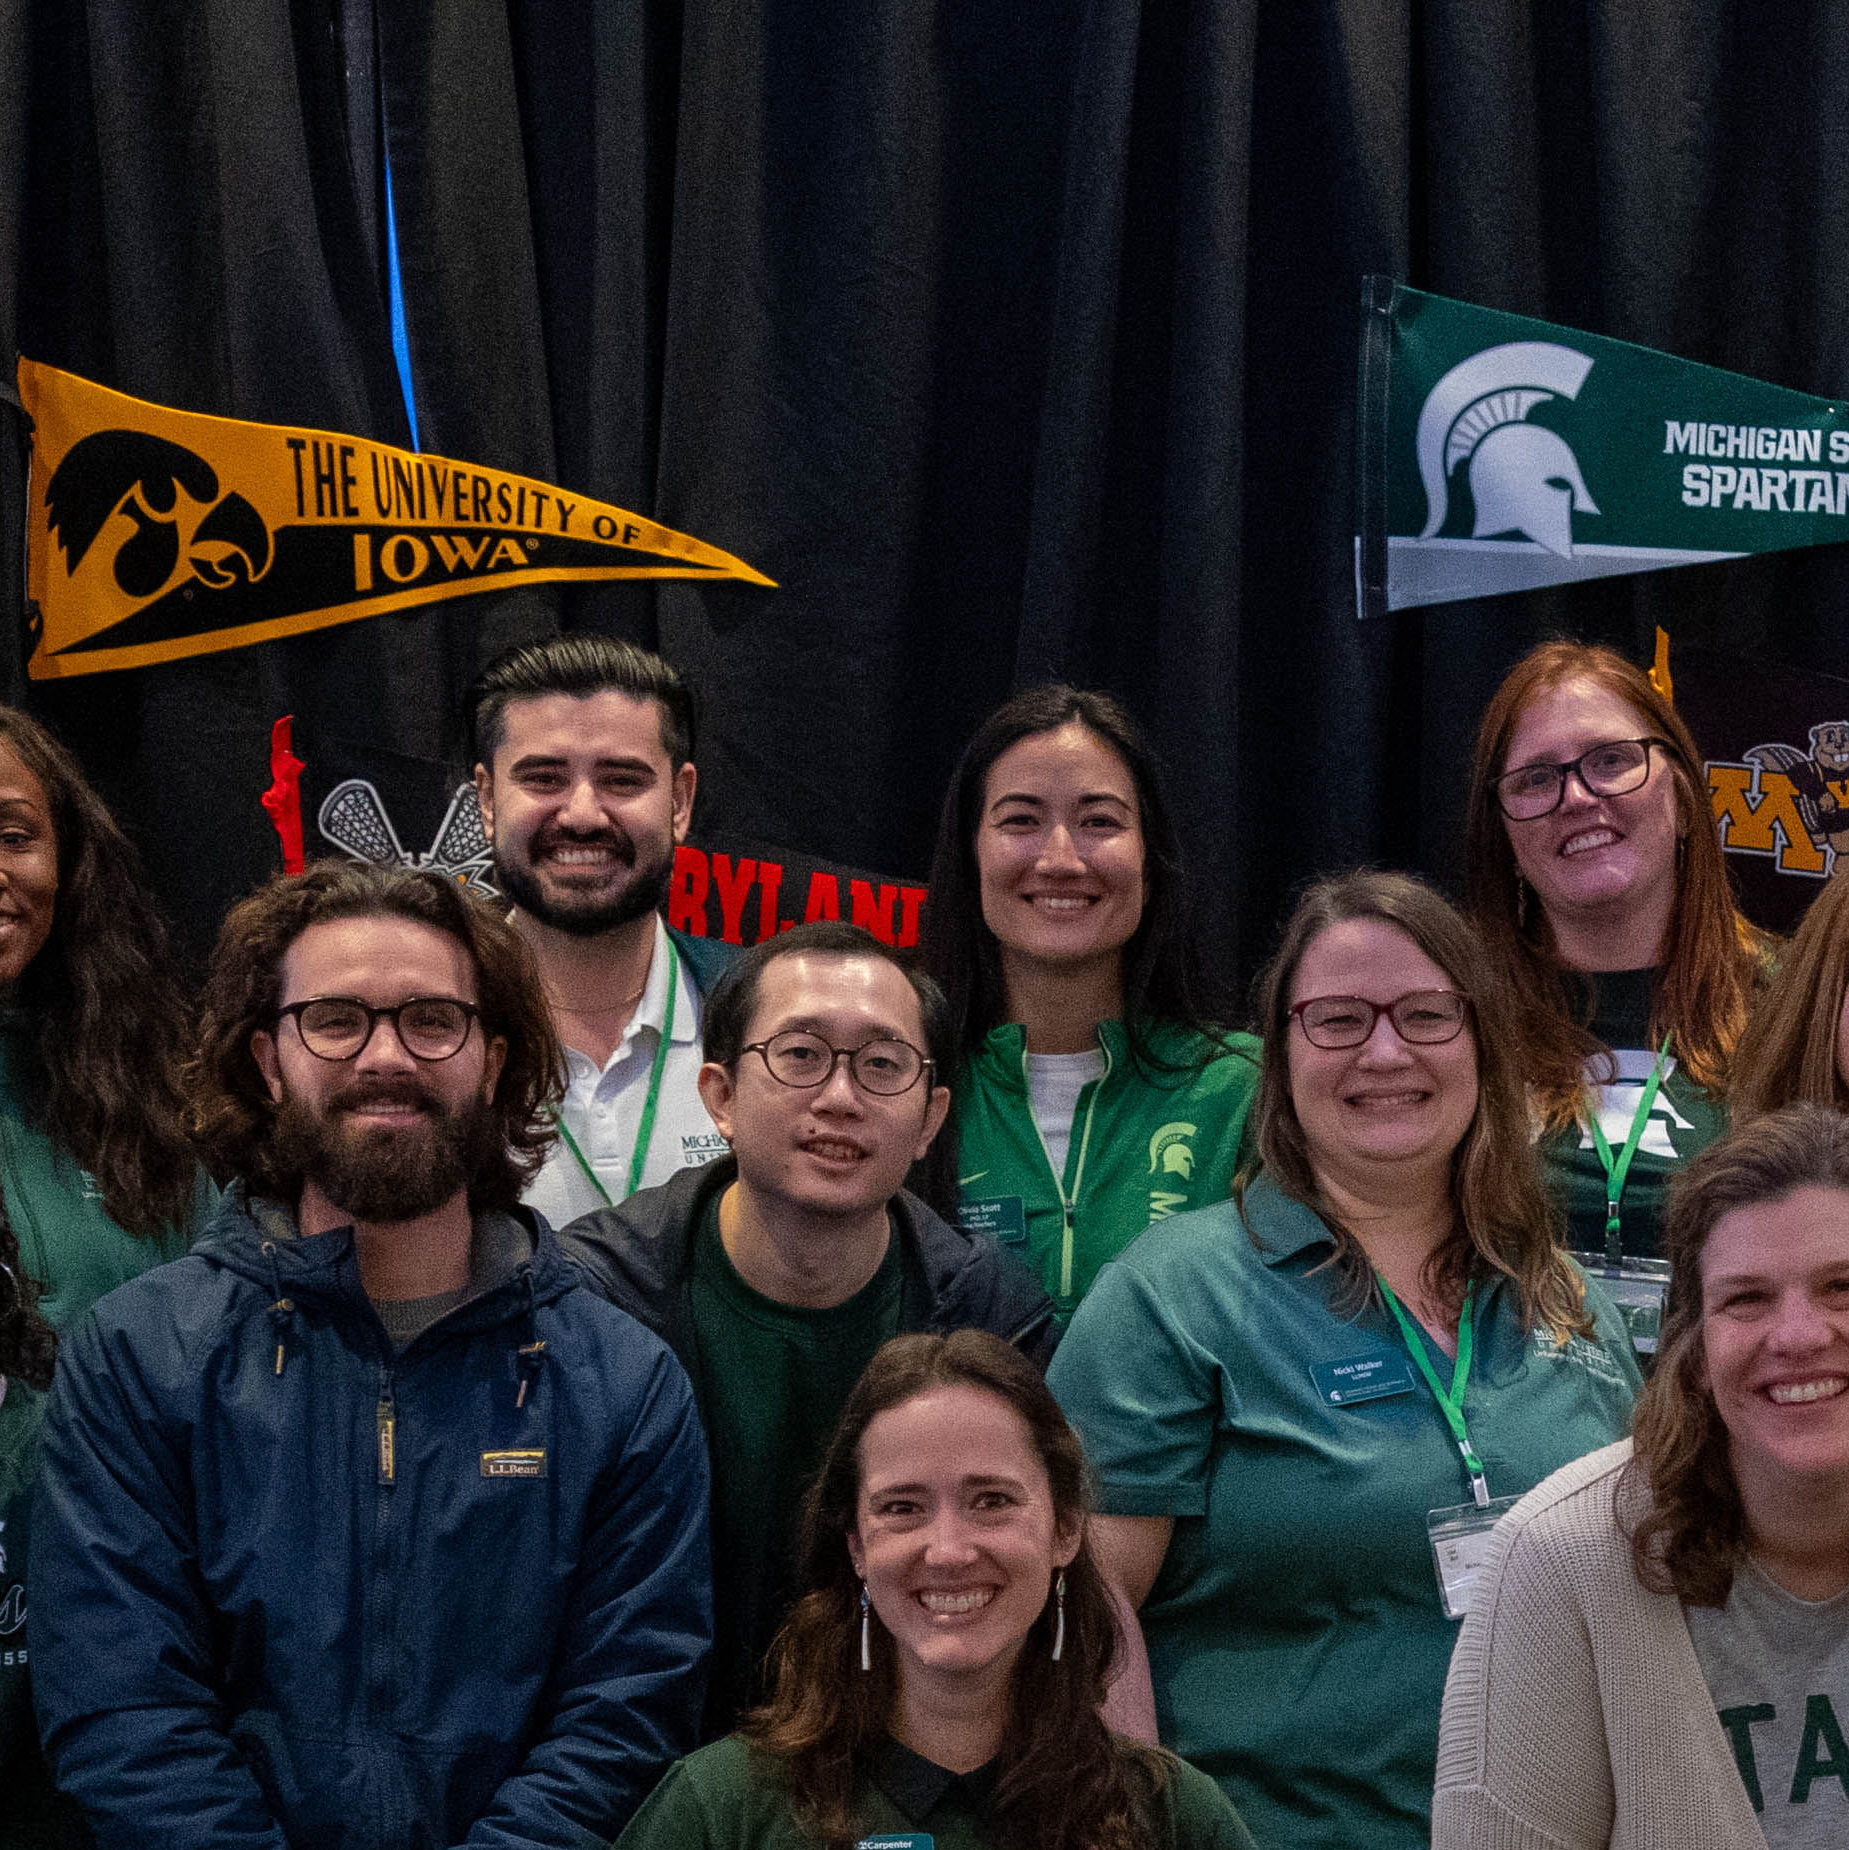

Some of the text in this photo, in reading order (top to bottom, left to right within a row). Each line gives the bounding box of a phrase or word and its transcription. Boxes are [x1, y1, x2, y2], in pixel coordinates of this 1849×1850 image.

[1662, 420, 1822, 462] MICHIGAN
[287, 437, 642, 545] THE UNIVERSITY OF
[353, 534, 528, 591] IOWA
[668, 845, 928, 948] RYLAN
[867, 1841, 913, 1850] Carpenter
